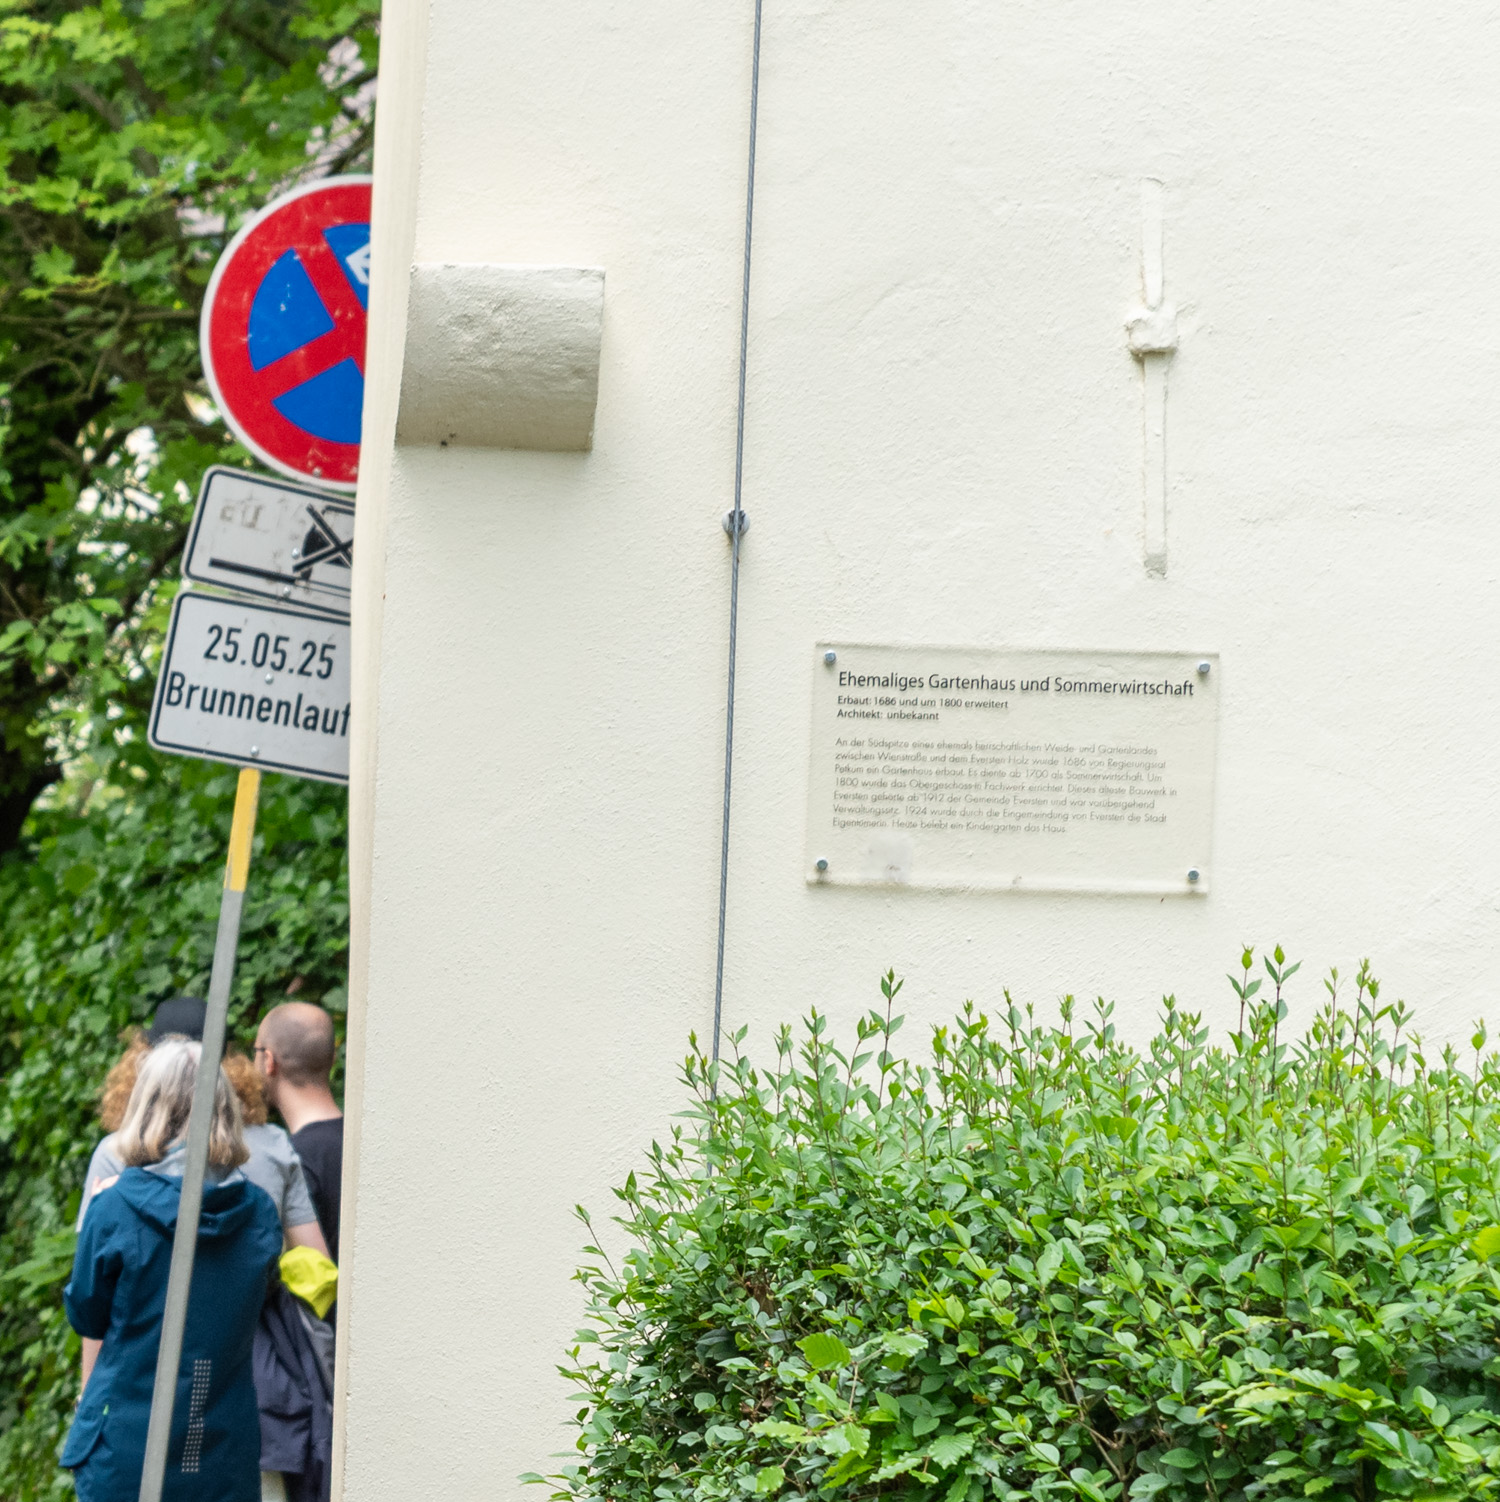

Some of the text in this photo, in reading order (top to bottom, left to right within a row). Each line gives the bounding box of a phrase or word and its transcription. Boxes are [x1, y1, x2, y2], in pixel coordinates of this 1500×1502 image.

[203, 624, 337, 680] 25.05.25
[839, 671, 1194, 696] Ehemaliges Gartenhaus und Sommerwirtschaft
[165, 671, 350, 737] Brunnenlauf
[838, 696, 1008, 708] Erbaut: 1686 und um 1800 erweitert
[837, 709, 939, 720] Architekt: unbekannt
[835, 738, 847, 746] An
[850, 739, 864, 747] der
[937, 741, 972, 750] ehemals
[1080, 744, 1095, 752] und
[1098, 745, 1157, 755] Gartenlandes
[835, 751, 874, 760] zwischen
[930, 754, 946, 762] und
[970, 756, 1005, 764] Eversten
[1008, 756, 1028, 764] Holz
[1032, 757, 1058, 765] wurde
[1063, 757, 1086, 766] 1686
[882, 766, 932, 775] Gartenhaus
[968, 768, 977, 776] Es
[981, 768, 1006, 777] diente
[1010, 770, 1021, 778] ab
[1025, 770, 1048, 778] 1700
[1052, 771, 1063, 779] als
[1147, 774, 1161, 782] Um
[836, 778, 858, 787] 1800
[861, 778, 888, 788] wurde
[891, 779, 906, 788] das
[985, 782, 1025, 791] Fachwerk
[1068, 784, 1095, 793] Dieses
[1129, 786, 1166, 795] Bauwerk
[1170, 787, 1177, 795] in
[834, 791, 868, 800] Eversten
[908, 793, 919, 801] ab
[924, 793, 944, 802] 1912
[947, 794, 961, 802] der
[965, 795, 1010, 804] Gemeinde
[1014, 796, 1048, 805] Eversten
[1051, 797, 1067, 805] und
[905, 807, 927, 815] 1924
[930, 807, 957, 816] wurde
[960, 808, 983, 816] durch
[986, 808, 999, 817] die
[1090, 812, 1125, 821] Eversten
[1128, 814, 1141, 822] die
[1145, 814, 1166, 822] Stadt
[892, 820, 917, 828] Heute
[921, 820, 948, 829] belebt
[967, 822, 1021, 833] Kindergarten
[1024, 823, 1040, 832] das
